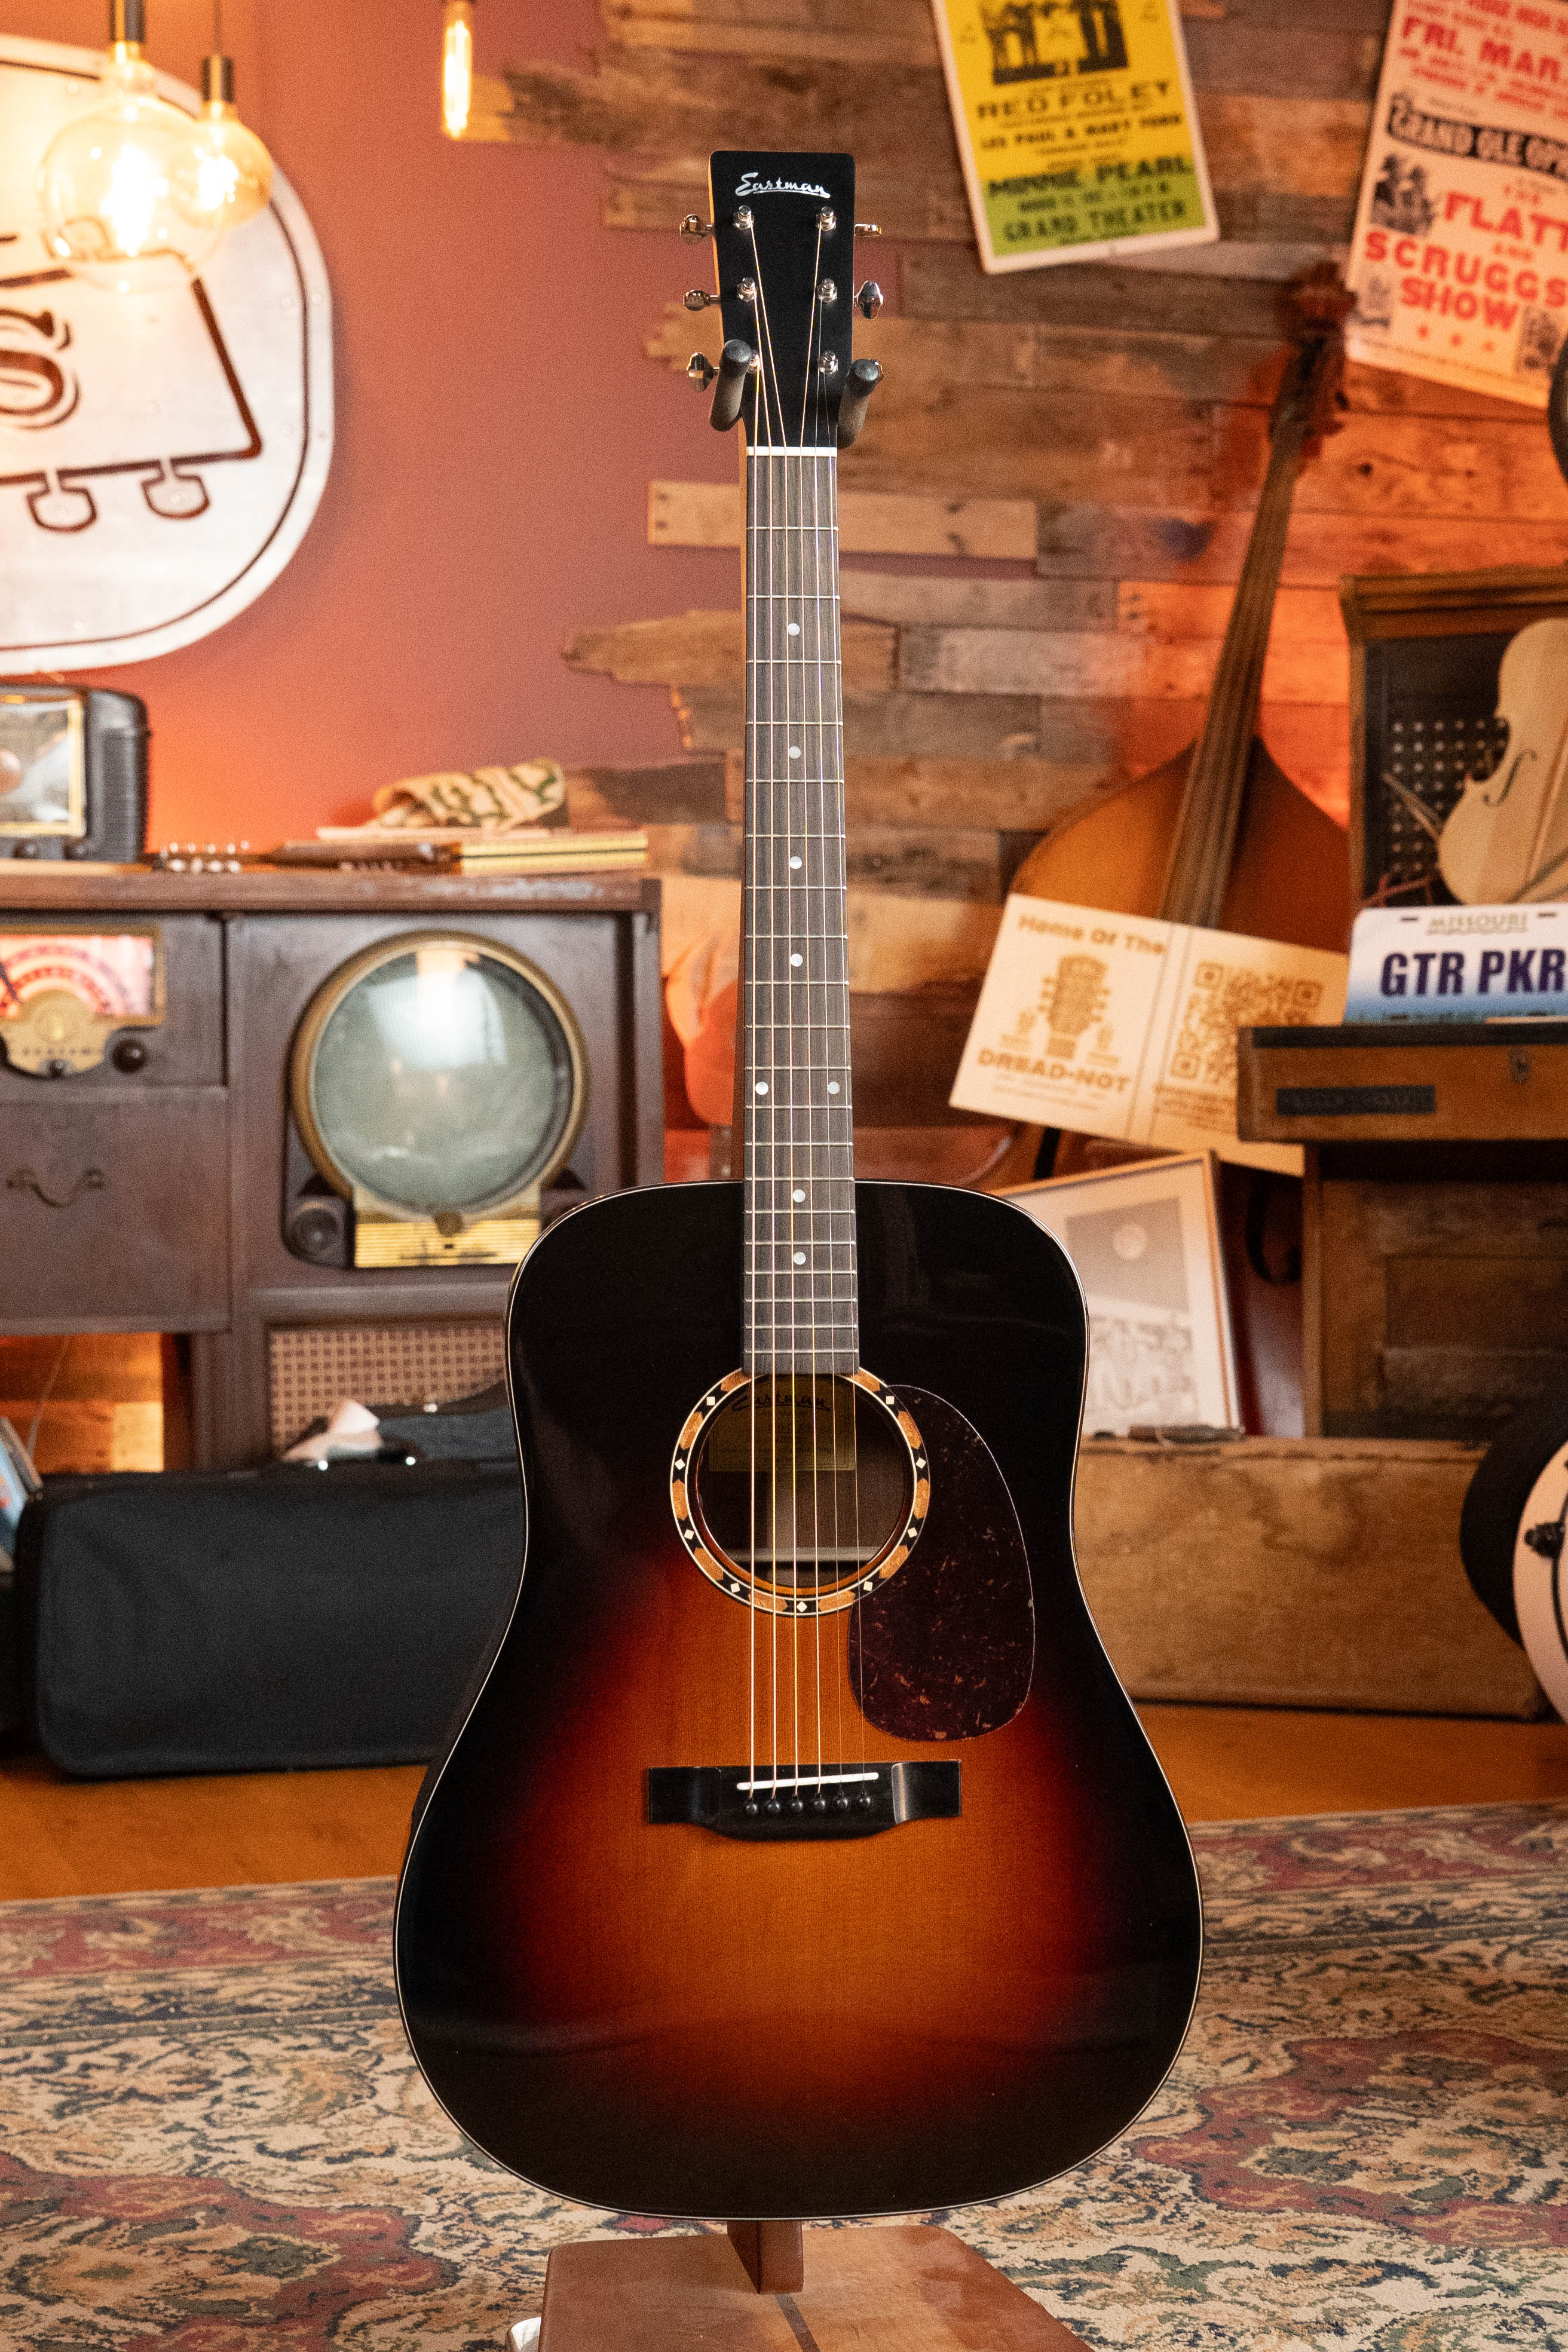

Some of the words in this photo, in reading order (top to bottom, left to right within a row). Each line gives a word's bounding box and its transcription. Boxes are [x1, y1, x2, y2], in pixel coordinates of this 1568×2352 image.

[1059, 79, 1169, 109] FOLEY
[735, 172, 831, 198] Eastman
[1444, 191, 1568, 252] FLATT
[1365, 230, 1568, 309] SCRUGGS
[1401, 276, 1518, 332] SHOW
[1018, 914, 1084, 942] Home
[1090, 927, 1119, 947] Of
[1123, 933, 1167, 956] The
[1427, 912, 1528, 935] MISSOURI
[1380, 952, 1464, 997] GTR
[1477, 948, 1567, 994] PKR
[977, 1048, 1132, 1094] DREAD-NOT
